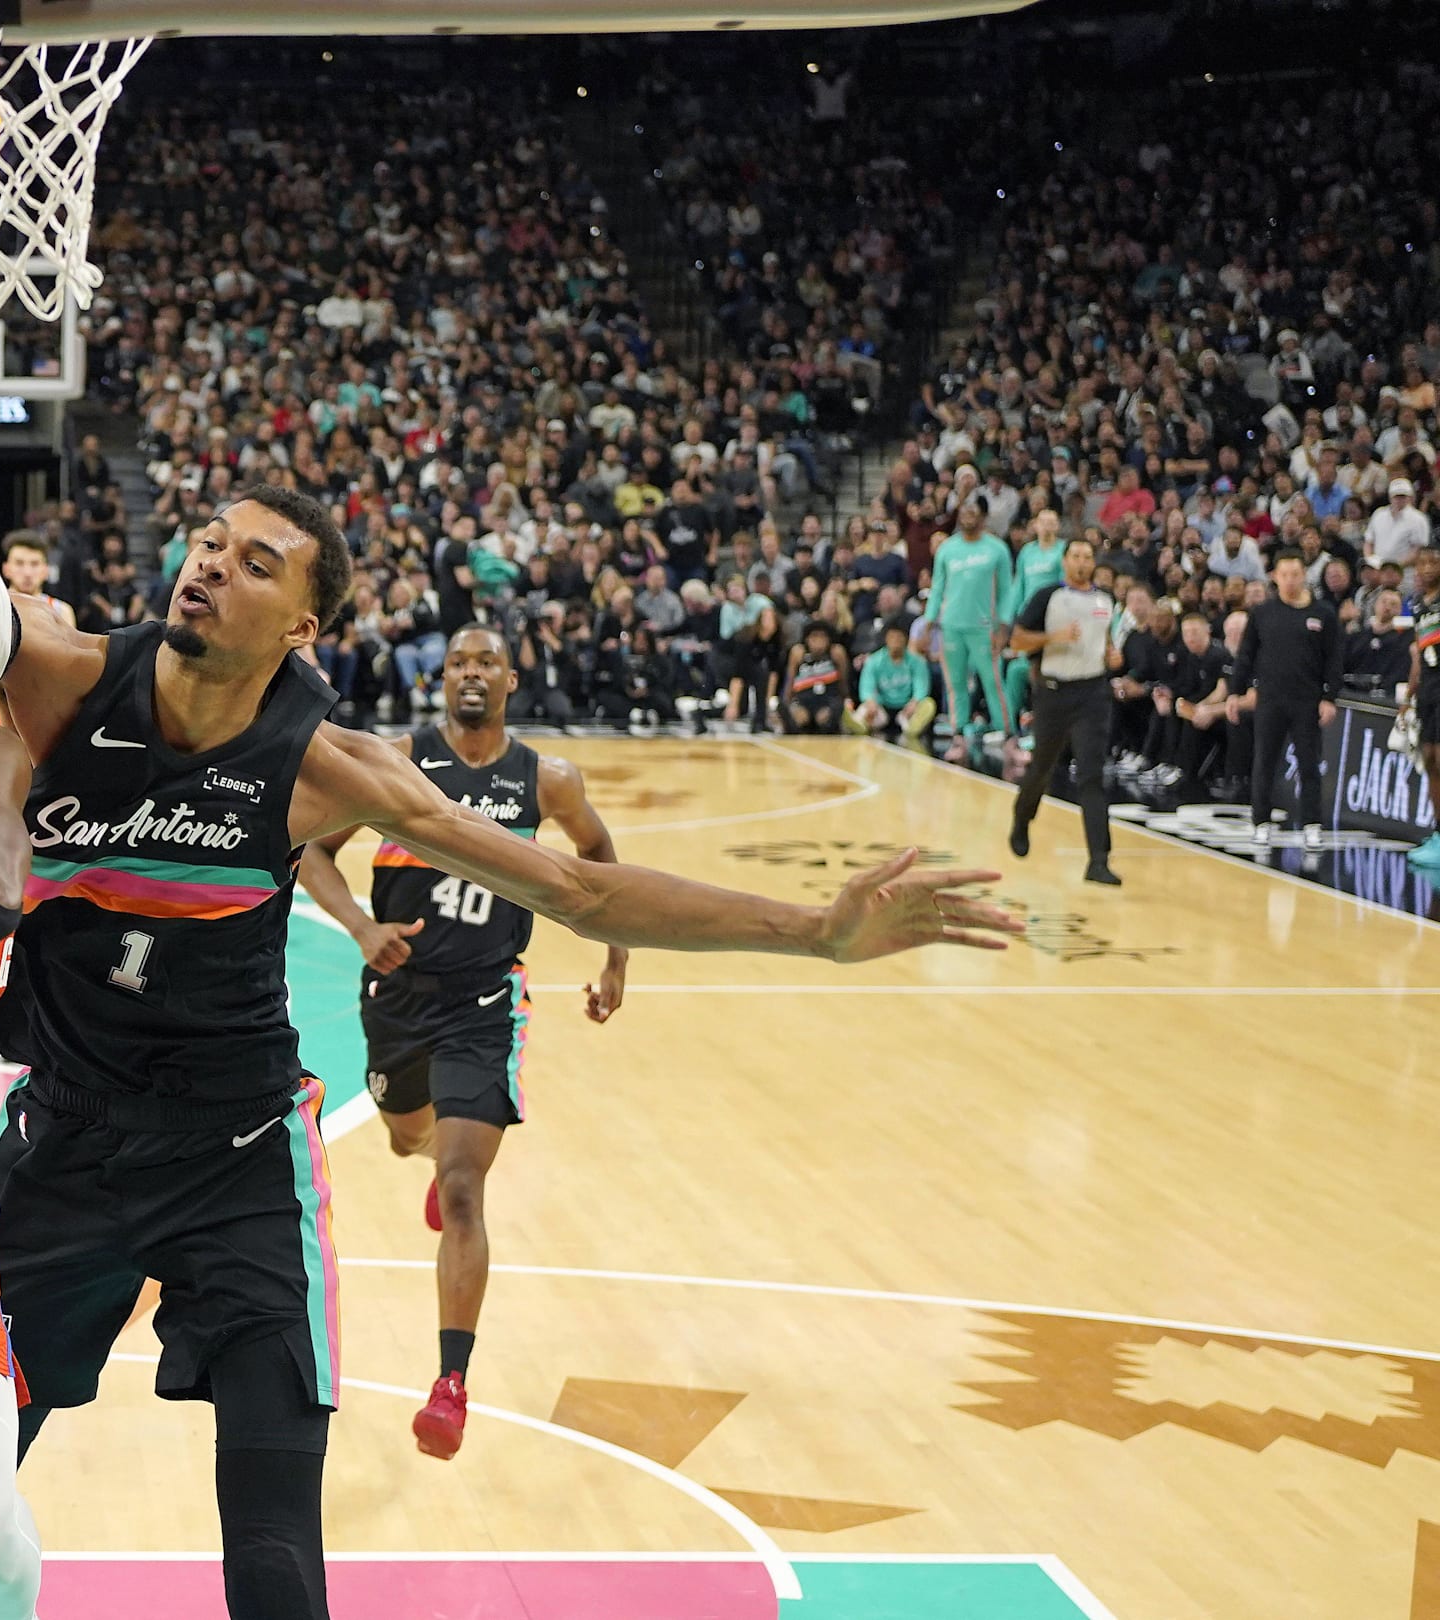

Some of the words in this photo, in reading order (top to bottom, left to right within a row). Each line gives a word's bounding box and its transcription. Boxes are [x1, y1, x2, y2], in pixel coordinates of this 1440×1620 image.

[212, 774, 255, 796] LEDGER
[1347, 728, 1415, 823] JACK
[29, 795, 109, 848] San
[108, 798, 248, 850] Antonio
[430, 875, 494, 926] 40
[107, 929, 155, 994] 1
